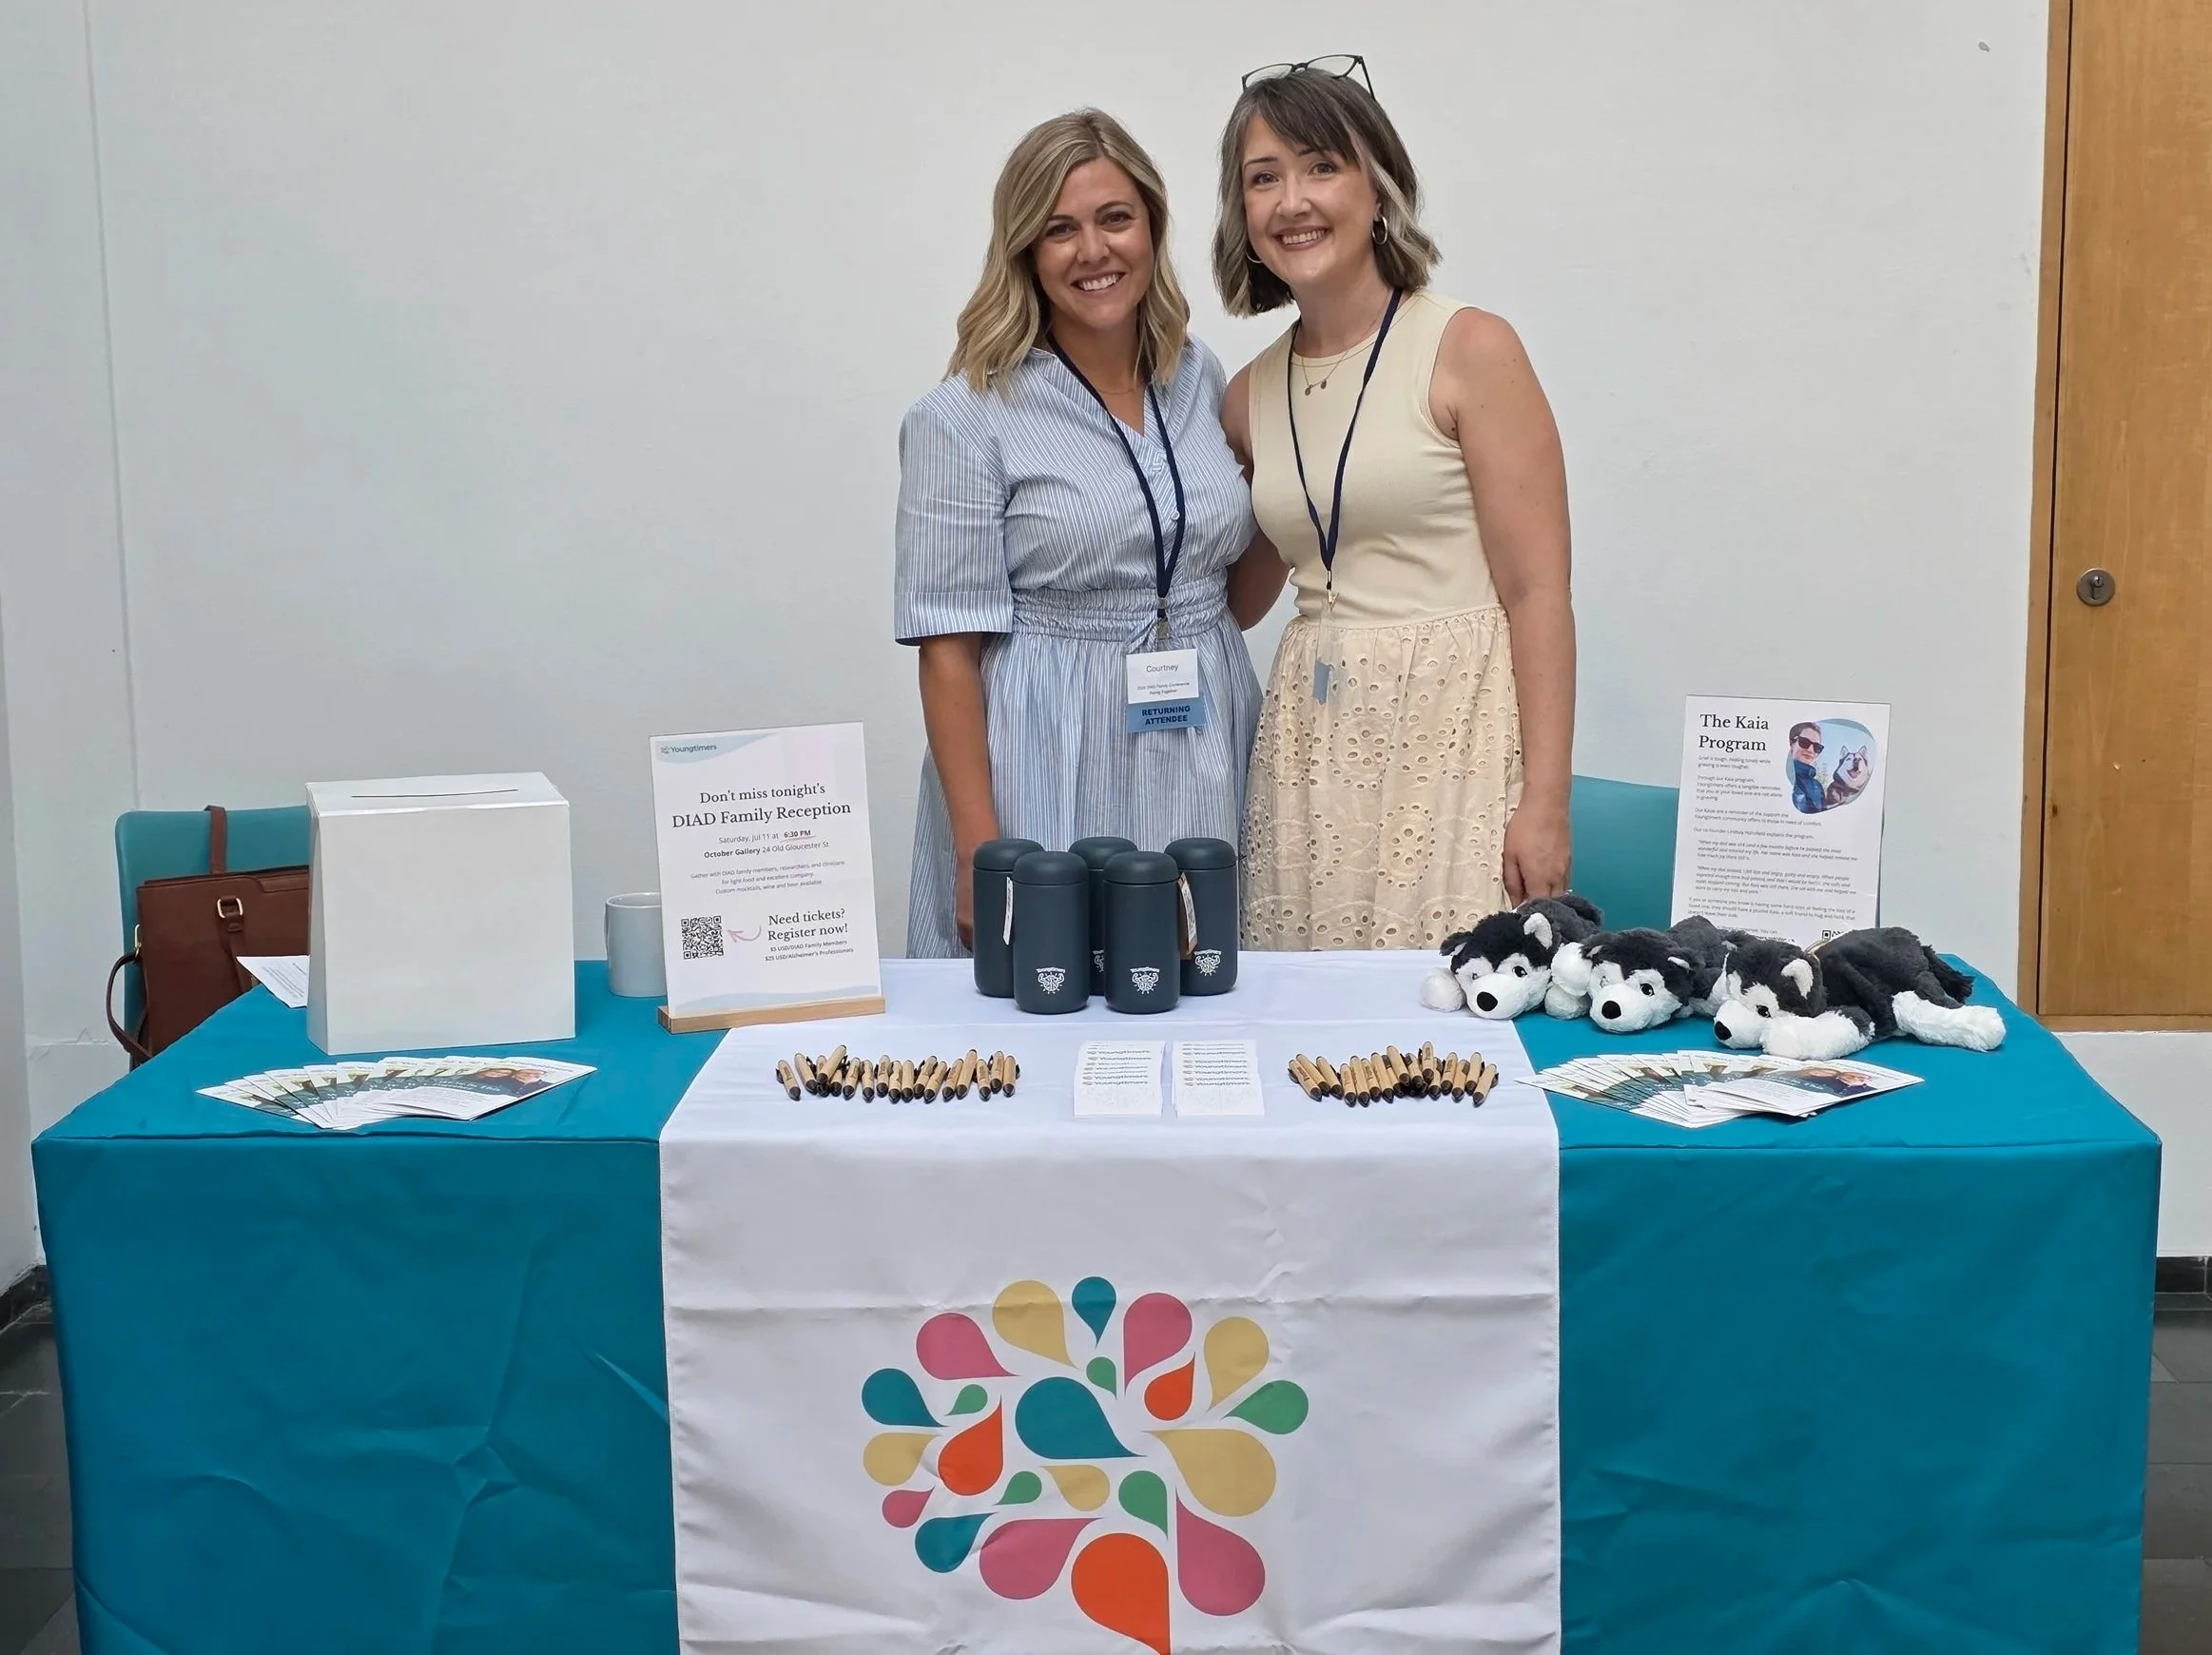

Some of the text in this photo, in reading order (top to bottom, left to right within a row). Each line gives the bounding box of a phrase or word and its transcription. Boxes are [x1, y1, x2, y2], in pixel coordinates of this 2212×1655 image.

[1146, 664, 1178, 673] Courtney
[1142, 706, 1191, 716] RETURNING
[1145, 714, 1188, 726] ATTENDEE
[1699, 713, 1769, 730] The Kaia
[669, 745, 717, 753] Youngtimers
[1698, 735, 1766, 753] Program
[700, 783, 825, 804] Don't miss tonight's
[672, 802, 851, 828] DIAD Family Reception
[719, 835, 751, 844] Saturday,
[704, 850, 733, 859] October
[734, 847, 761, 856] Gallery
[786, 843, 821, 852] Gloucester
[768, 908, 845, 925] Need tickets?
[767, 923, 847, 942] Register now!
